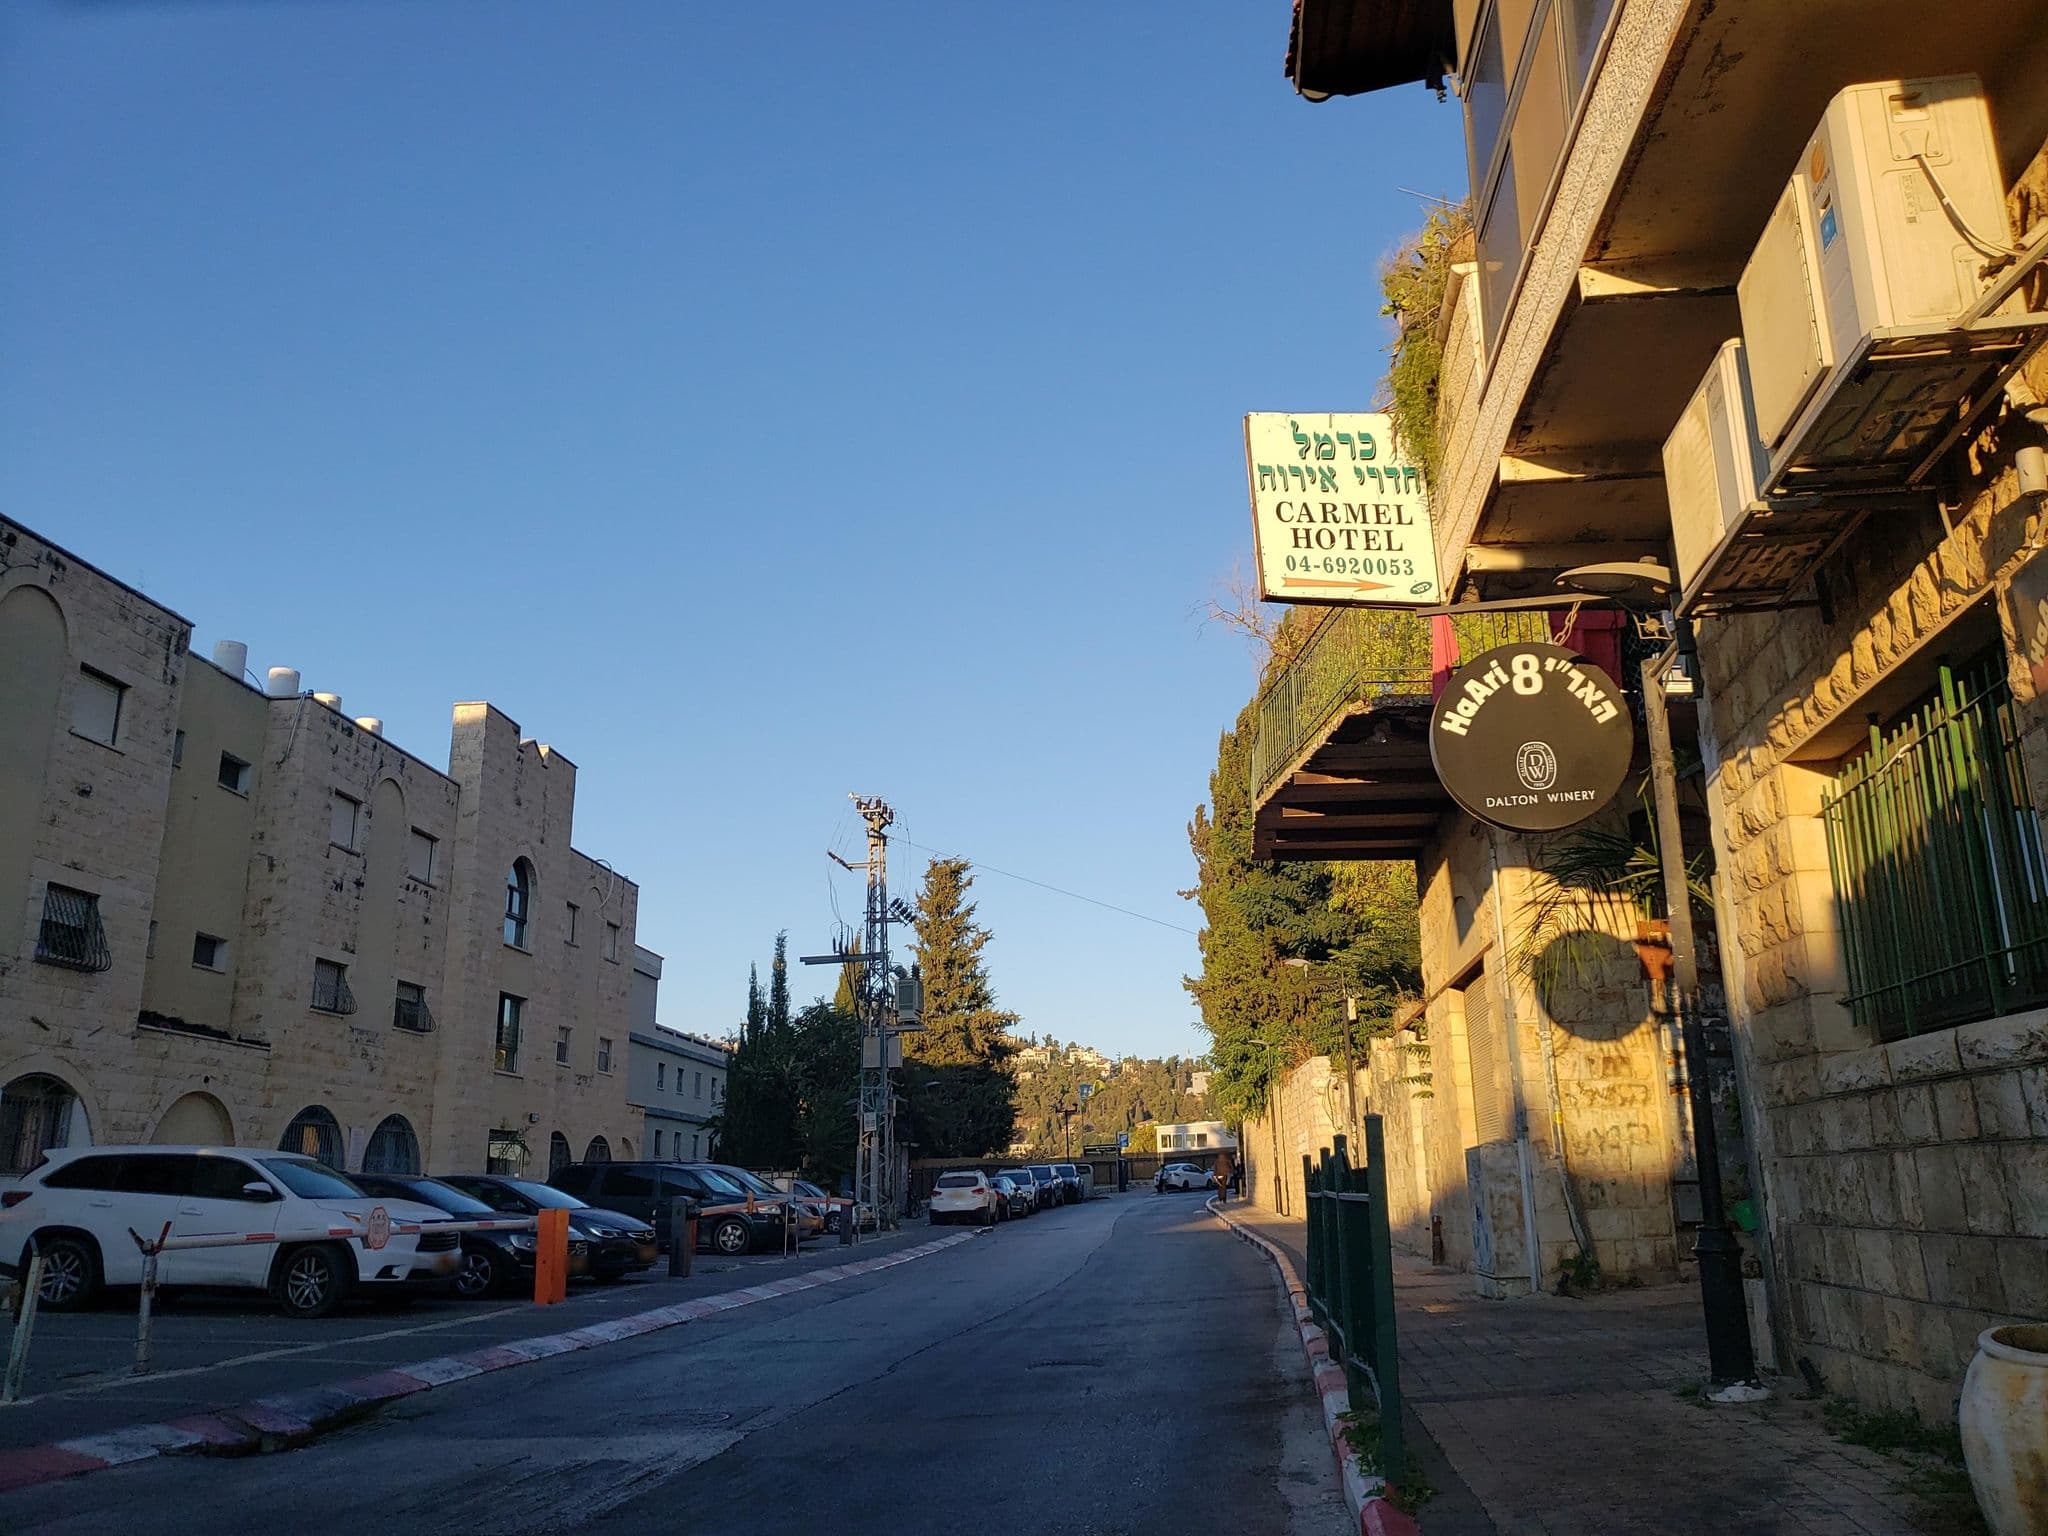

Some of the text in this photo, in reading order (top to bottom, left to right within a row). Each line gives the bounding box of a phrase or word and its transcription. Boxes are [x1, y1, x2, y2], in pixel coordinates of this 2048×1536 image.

[1291, 420, 1376, 460] כרמל
[1258, 464, 1421, 494] חדרי אירוח
[1275, 501, 1413, 525] CARMEL
[1290, 528, 1403, 552] HOTEL
[1286, 555, 1414, 576] 04-6920053
[1440, 659, 1510, 736] HaAri
[1511, 653, 1543, 695] 8
[1486, 789, 1596, 808] DALTON WINERY
